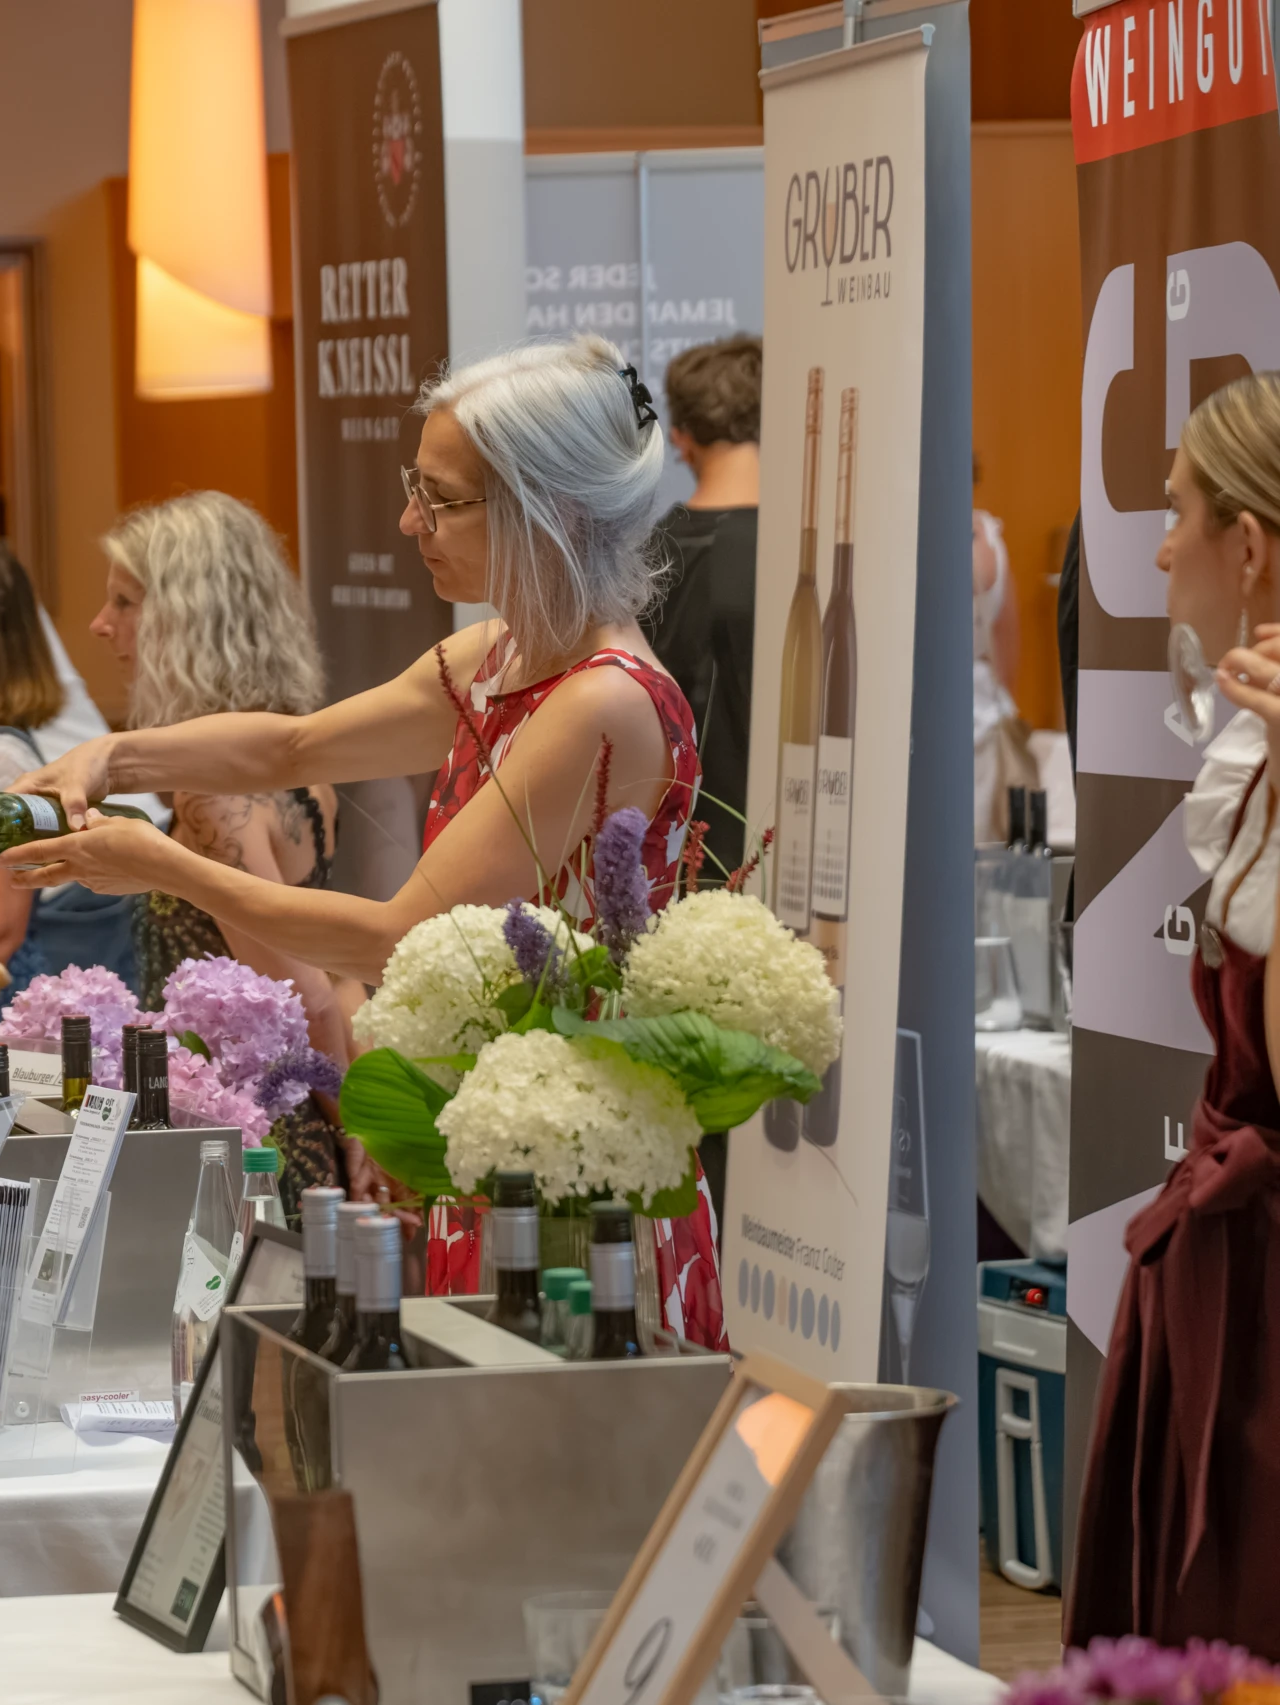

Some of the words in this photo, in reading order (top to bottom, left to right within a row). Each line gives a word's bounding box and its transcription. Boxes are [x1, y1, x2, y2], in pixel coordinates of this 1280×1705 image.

[1085, 0, 1269, 128] WEINGUT
[785, 155, 894, 284] GRUBER
[321, 257, 410, 324] RETTER
[837, 271, 891, 304] WEINBAU
[318, 333, 415, 398] KNEISSL
[12, 1067, 54, 1085] Blauburger
